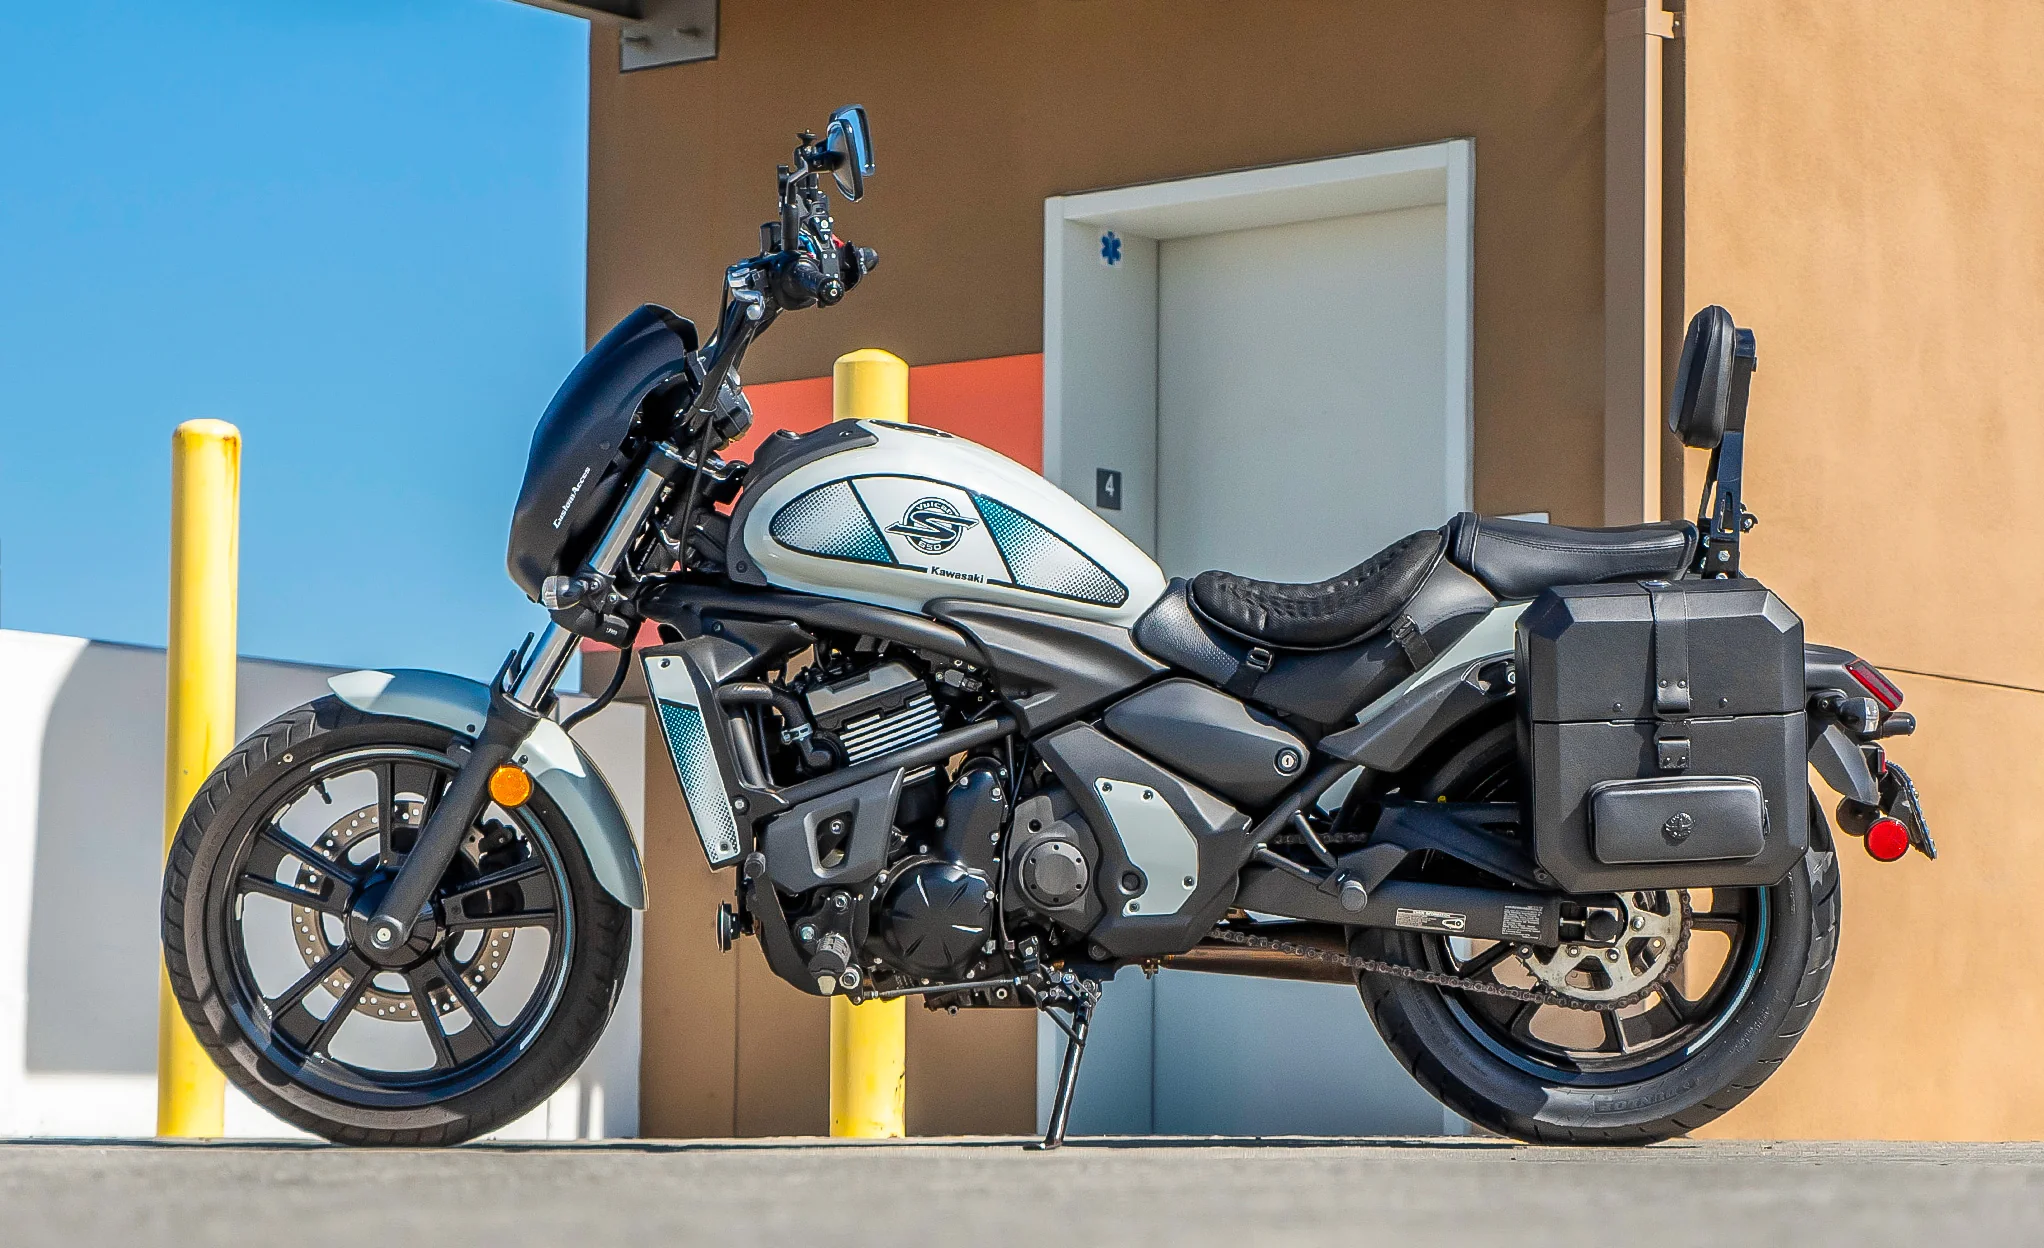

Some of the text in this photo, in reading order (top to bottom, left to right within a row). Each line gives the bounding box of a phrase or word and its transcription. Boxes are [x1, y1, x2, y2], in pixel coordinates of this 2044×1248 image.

[1104, 473, 1115, 497] 4
[918, 540, 942, 551] 650
[930, 566, 984, 584] Kawasaki
